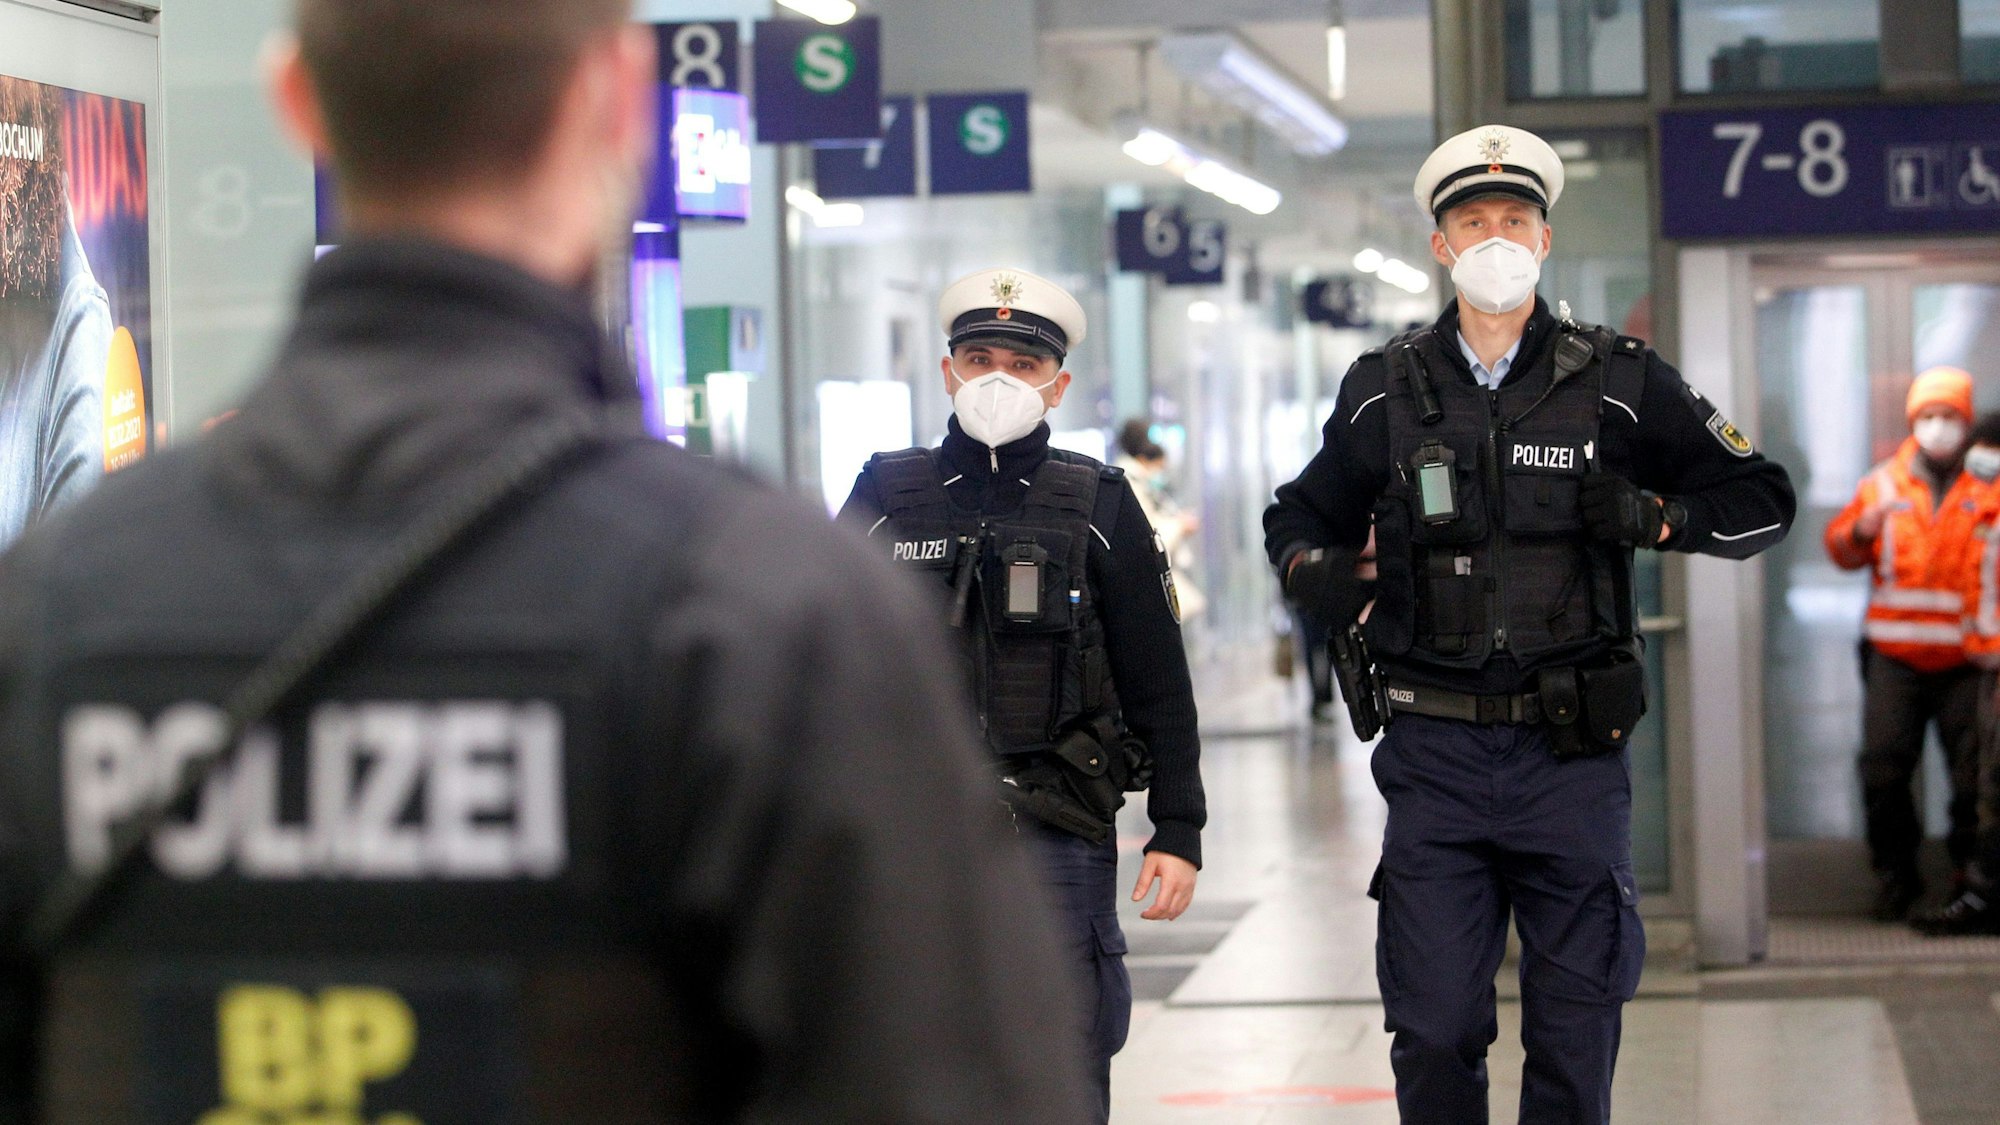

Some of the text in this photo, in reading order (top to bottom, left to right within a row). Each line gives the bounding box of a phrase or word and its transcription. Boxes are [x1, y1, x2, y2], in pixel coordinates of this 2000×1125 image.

[671, 24, 725, 88] 8
[801, 36, 847, 92] S
[962, 106, 1004, 155] S
[1713, 119, 1848, 198] 7-8
[1511, 444, 1575, 469] POLIZEI
[893, 538, 948, 560] POLIZEI
[61, 703, 567, 879] POLIZEI
[216, 985, 417, 1108] BP
